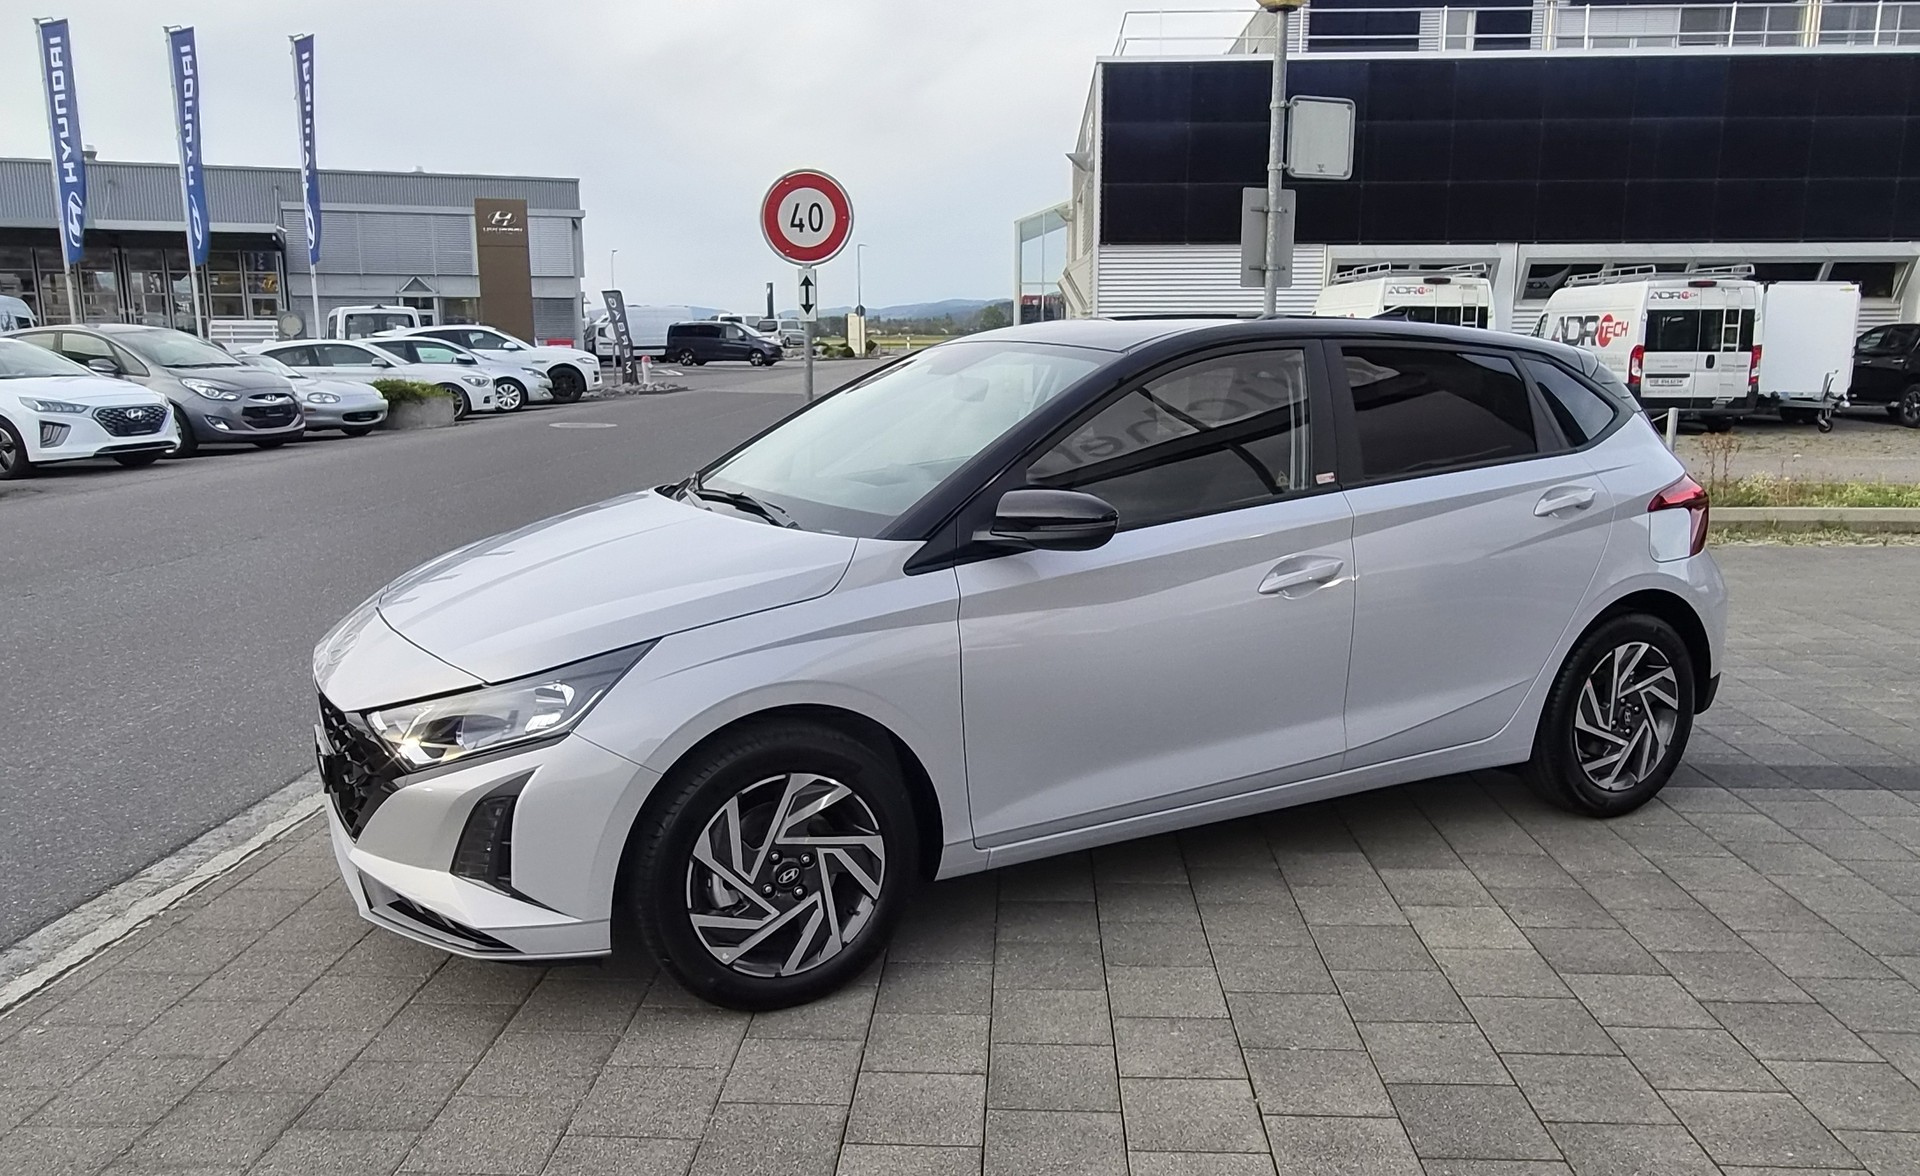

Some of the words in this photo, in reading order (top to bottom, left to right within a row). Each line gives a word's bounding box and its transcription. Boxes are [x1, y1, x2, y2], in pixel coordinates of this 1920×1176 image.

[49, 36, 78, 183] HYUNDAI
[179, 44, 195, 186] HYUNDAI
[790, 203, 824, 233] 40
